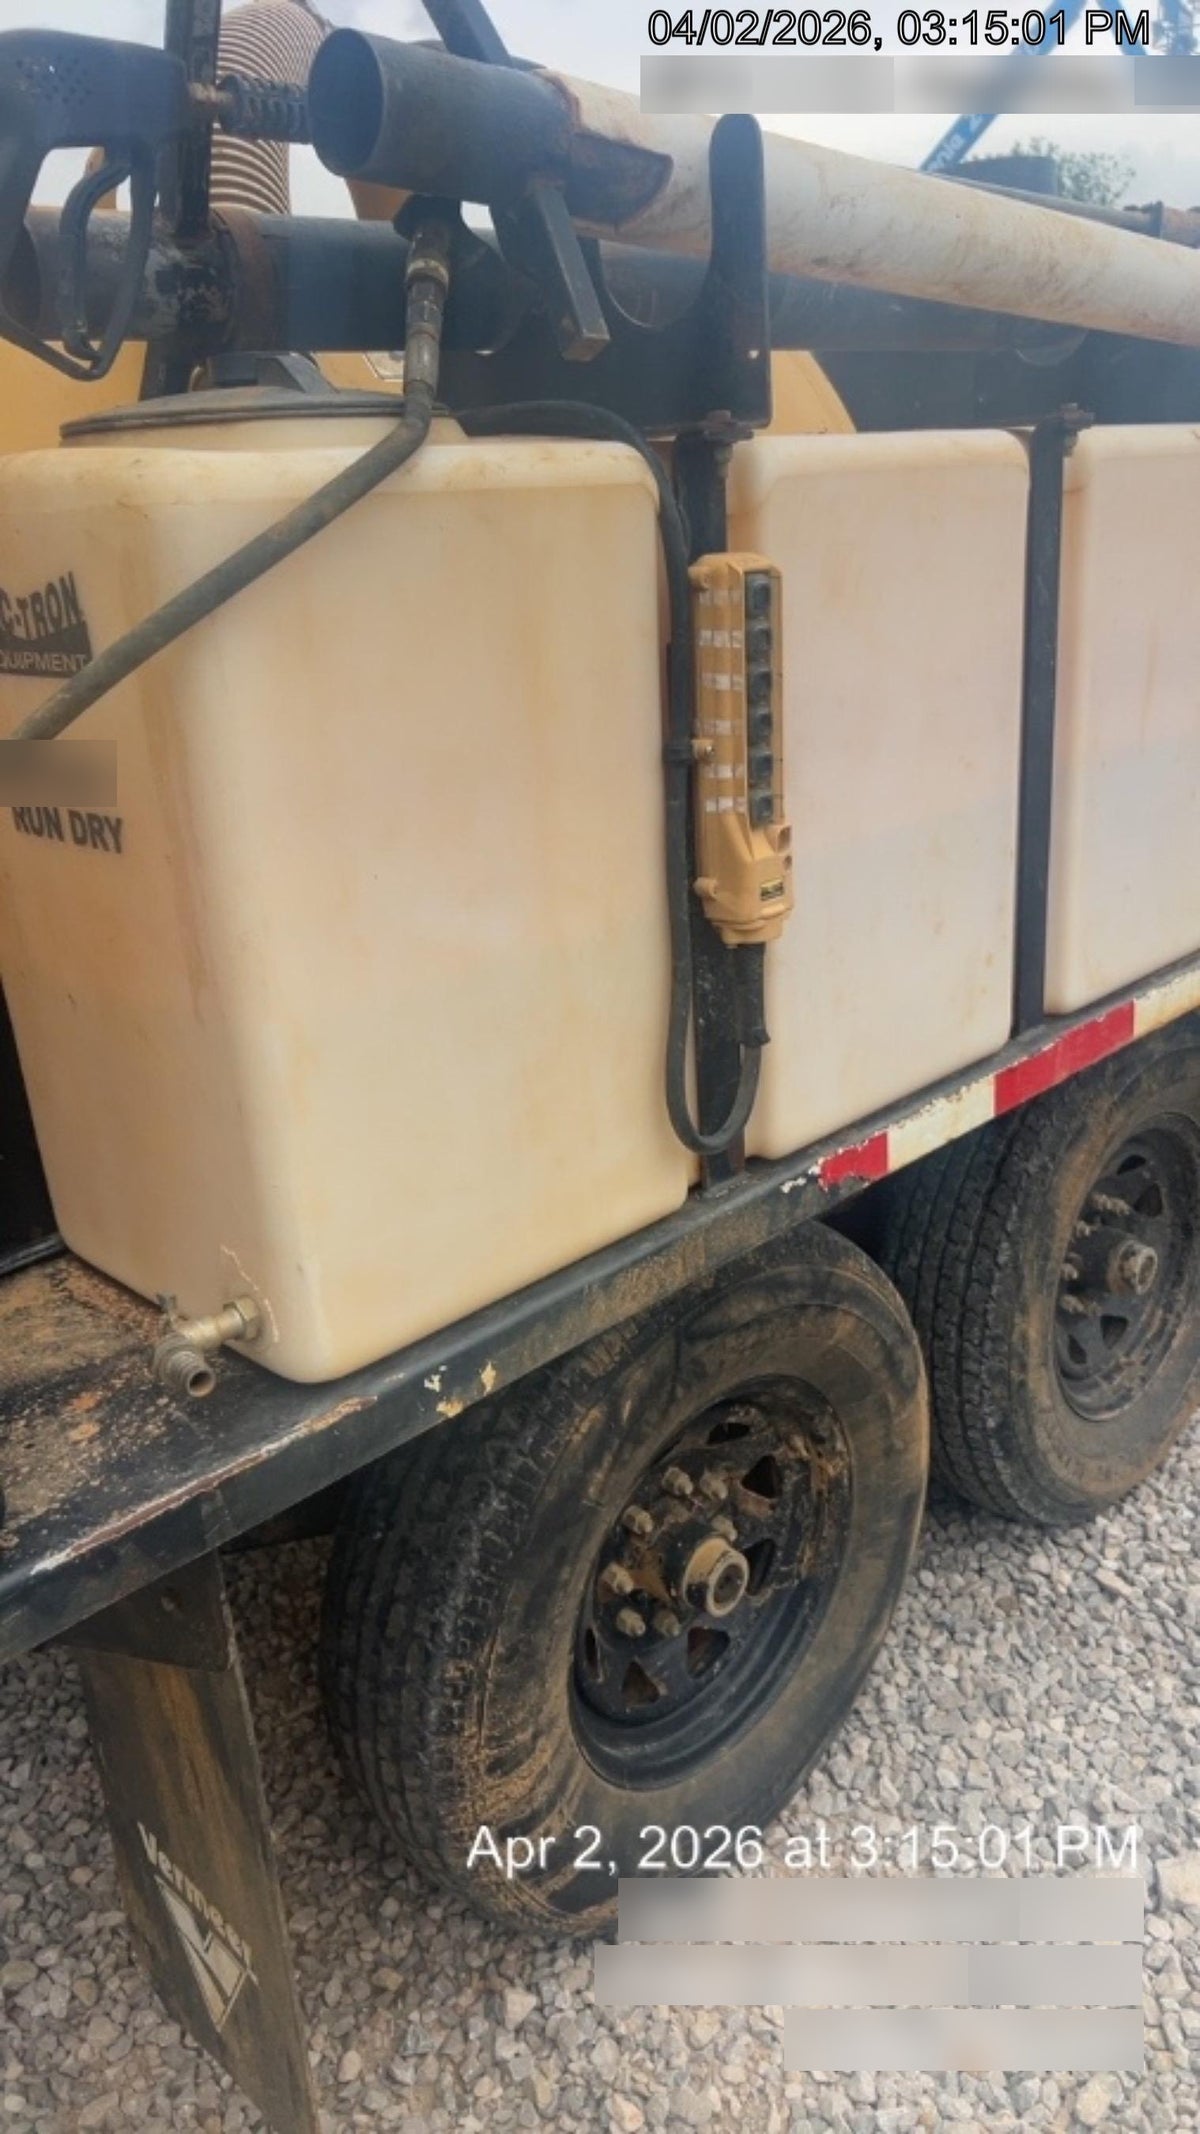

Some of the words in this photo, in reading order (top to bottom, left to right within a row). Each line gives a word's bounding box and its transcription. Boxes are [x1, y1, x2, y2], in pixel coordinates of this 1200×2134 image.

[11, 806, 65, 842] RUN
[67, 808, 123, 854] DRY
[137, 1821, 256, 1976] Vermeer
